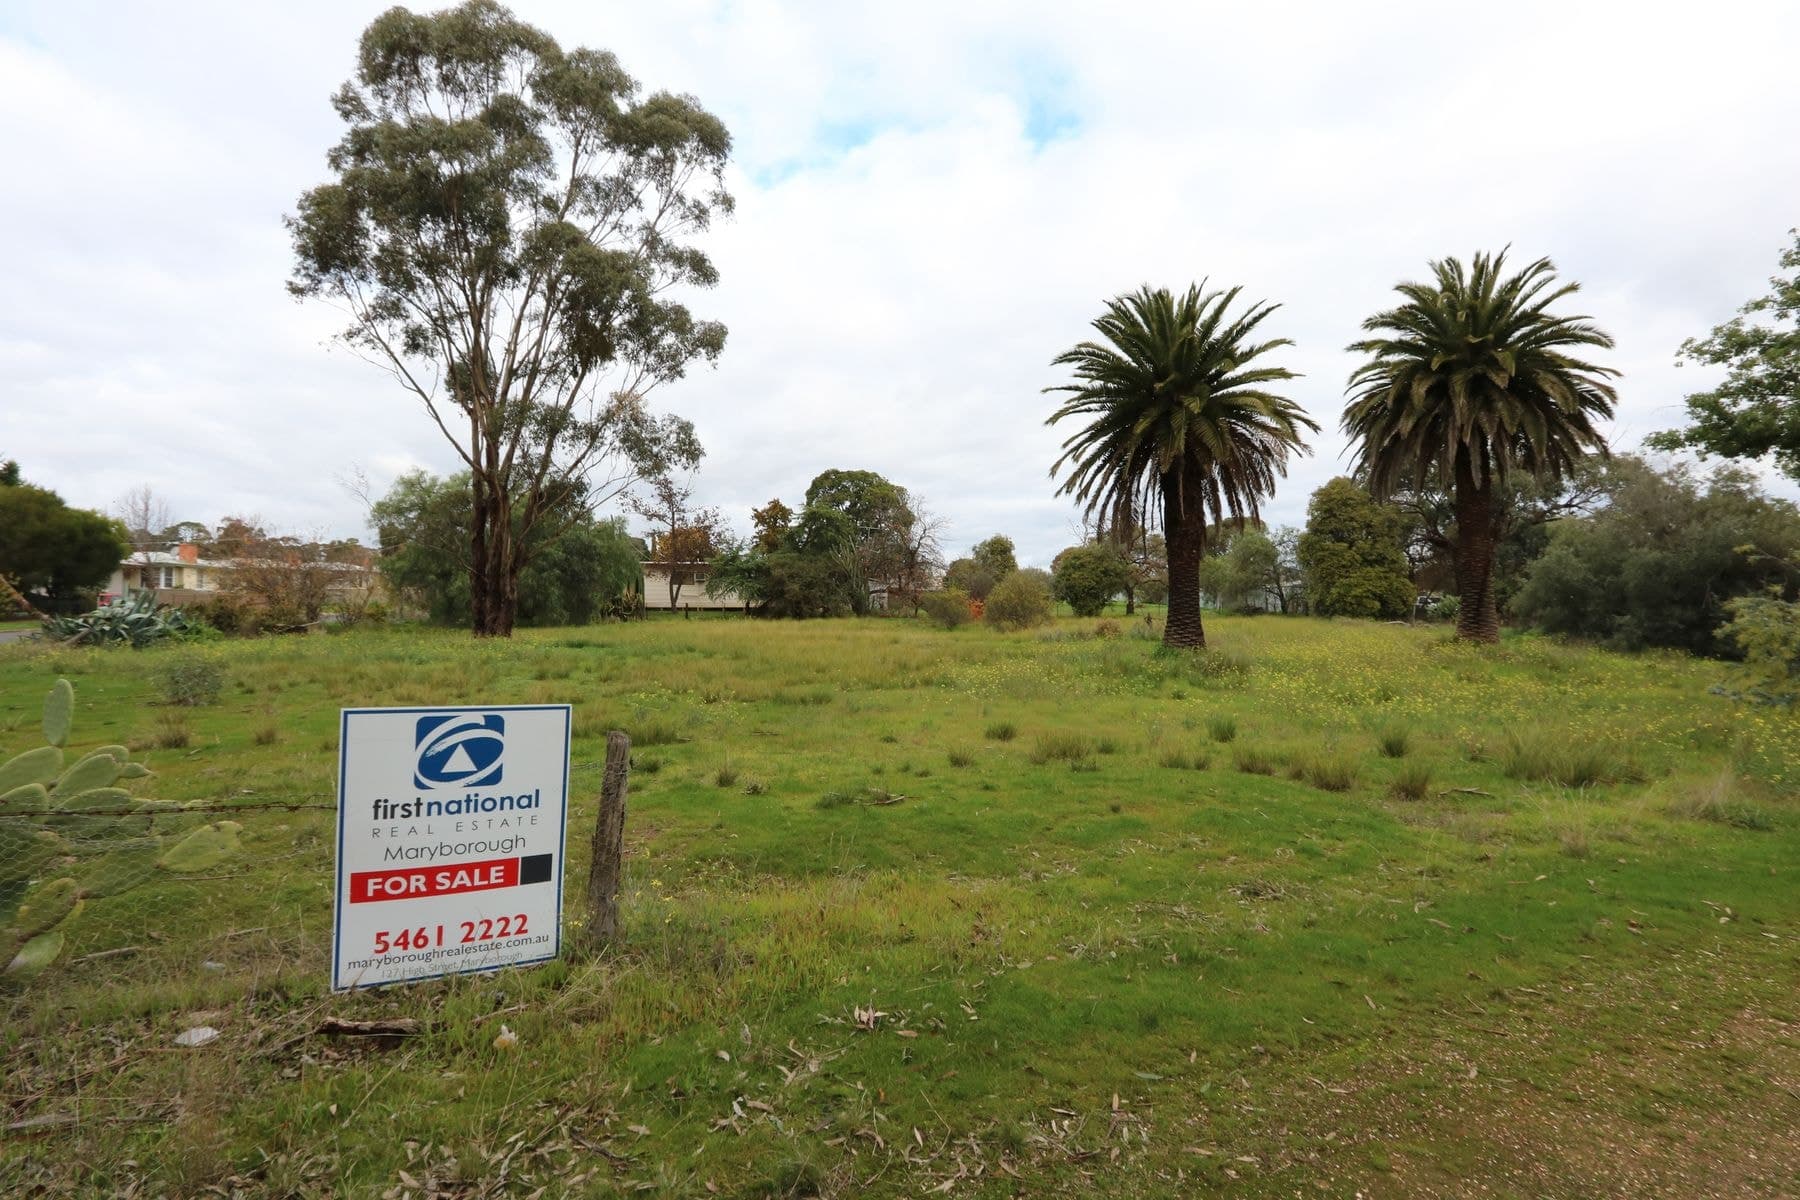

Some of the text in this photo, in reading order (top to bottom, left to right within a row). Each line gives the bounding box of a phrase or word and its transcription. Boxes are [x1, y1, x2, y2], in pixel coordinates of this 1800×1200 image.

[372, 815, 538, 838] REAL ESTATE
[384, 835, 526, 861] Maryborough
[367, 866, 505, 897] FOR SALE
[373, 914, 529, 954] 5461 2222
[347, 934, 550, 970] maryboroughrealestate.com.au
